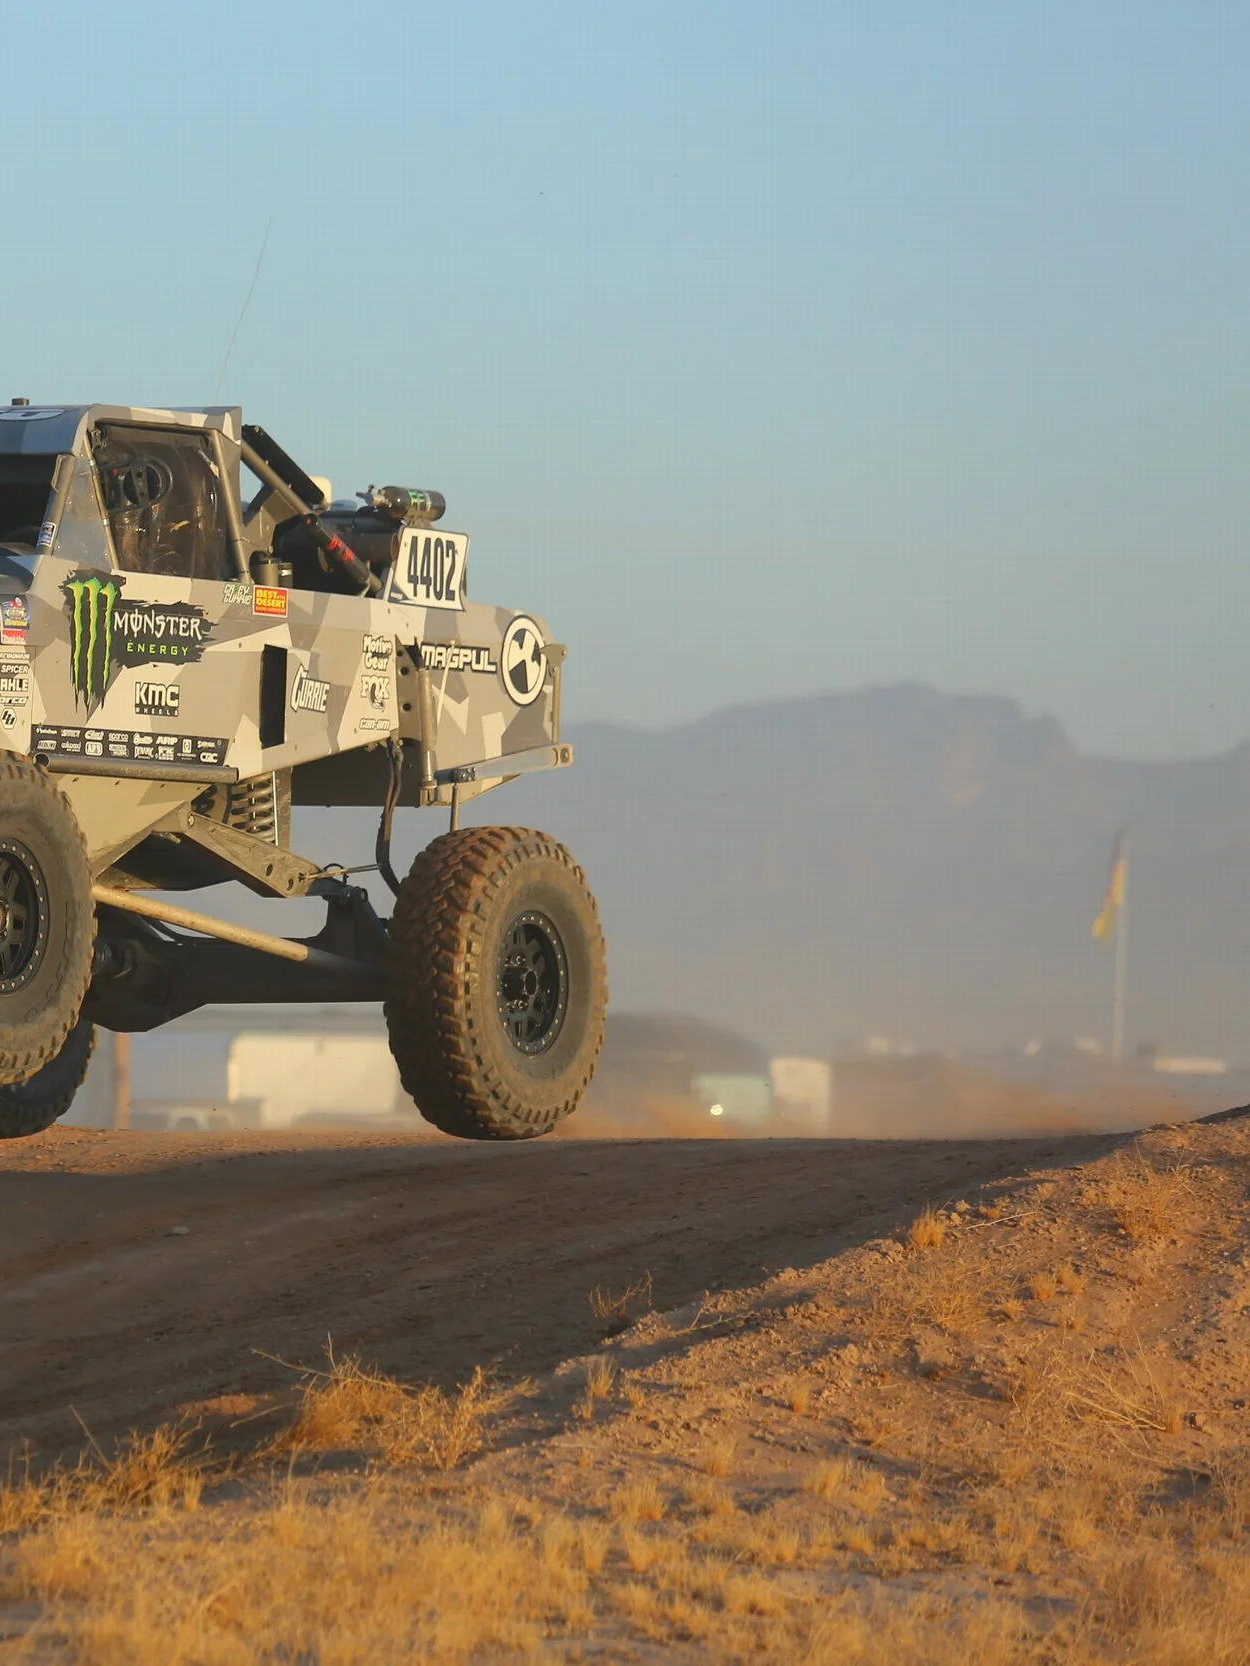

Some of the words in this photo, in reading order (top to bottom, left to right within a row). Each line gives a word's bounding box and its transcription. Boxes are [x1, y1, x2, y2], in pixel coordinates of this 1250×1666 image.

[407, 535, 457, 602] 4402
[256, 589, 278, 599] BEST
[256, 597, 286, 609] DESERT
[113, 608, 203, 641] MONSTER
[126, 640, 189, 657] ENERGY
[363, 635, 392, 655] Motive
[364, 652, 389, 671] Gear
[421, 642, 498, 674] MAGPUL
[0, 664, 29, 674] SPICER
[135, 682, 180, 708] KMC
[291, 664, 331, 713] CURRIE
[361, 675, 390, 702] FOX
[155, 735, 178, 745] ARP
[200, 751, 219, 763] CRC
